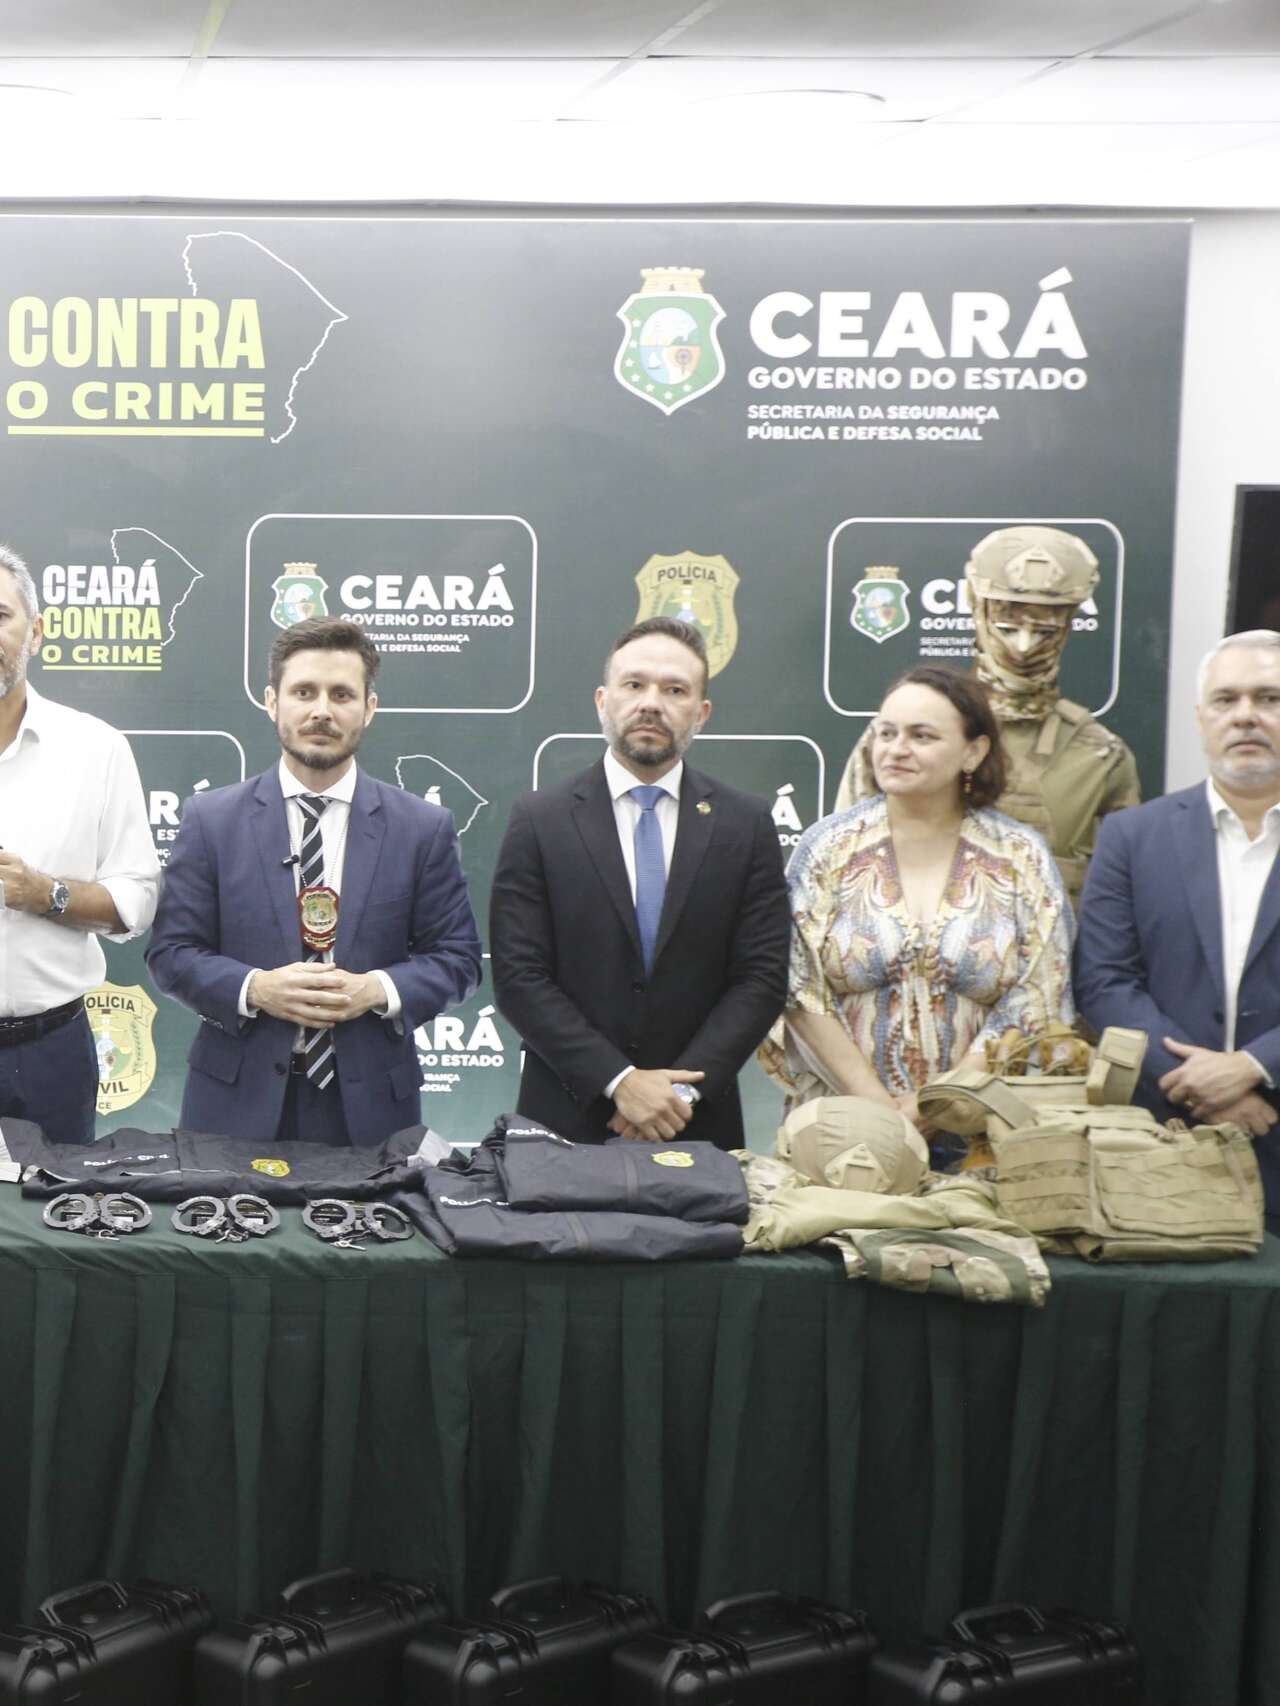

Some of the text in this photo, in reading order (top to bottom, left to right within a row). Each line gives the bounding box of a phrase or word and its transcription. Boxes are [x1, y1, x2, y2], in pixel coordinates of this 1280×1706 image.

[749, 266, 1088, 359] CEARÁ
[8, 296, 265, 369] CONTRA
[748, 366, 1087, 390] GOVERNO DO ESTADO
[6, 381, 265, 421] O CRIME
[748, 405, 999, 424] SECRETARIA DA SEGURANÇA
[747, 421, 983, 441] PÚBLICA E DEFESA SOCIAL
[42, 559, 160, 605] CEARÁ
[657, 564, 717, 582] POLÍCIA
[340, 563, 514, 610] CEARÁ
[43, 606, 162, 640] CONTRA
[340, 613, 514, 627] GOVERNO DO ESTADO
[390, 644, 425, 652] DEFESA
[427, 644, 461, 652] SOCIAL
[412, 634, 470, 644] SEGURANÇA
[42, 645, 162, 664] O CRIME
[86, 995, 135, 1012] OLÍCIA
[441, 1054, 504, 1067] ESTADO
[98, 1102, 112, 1110] CE
